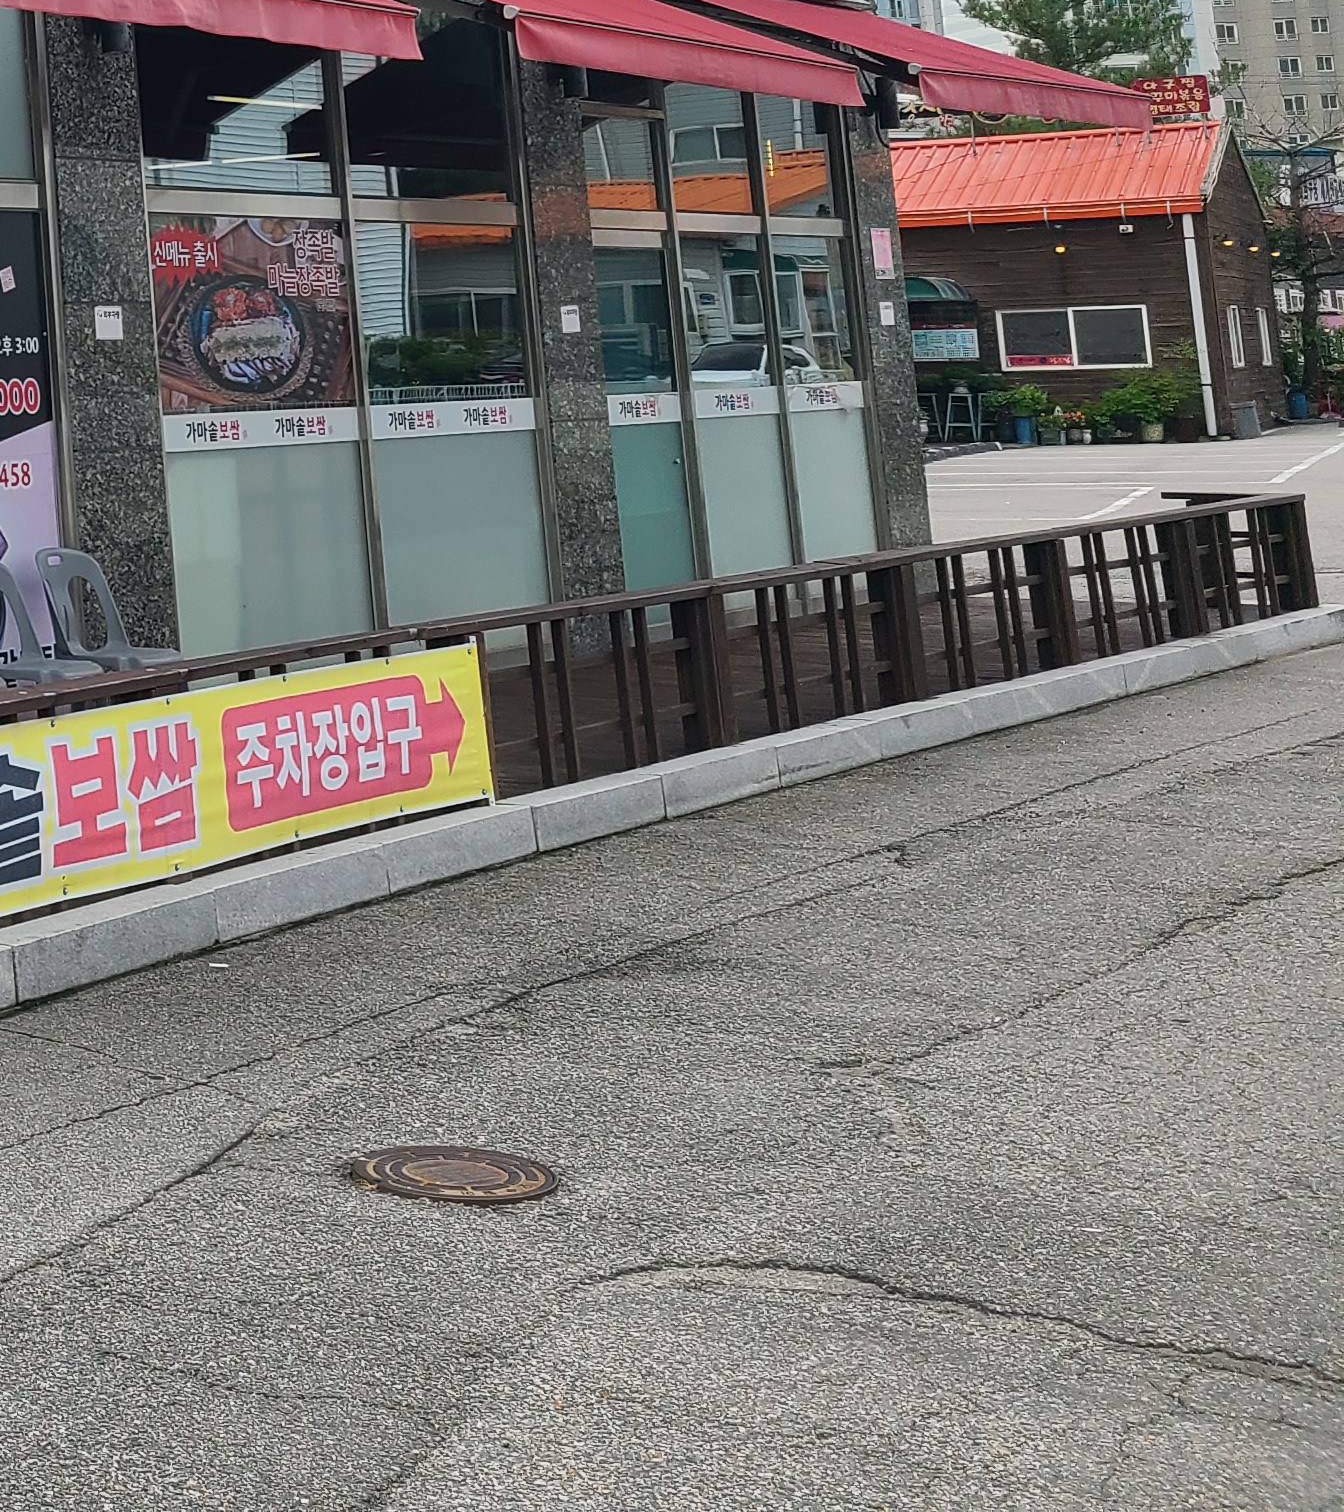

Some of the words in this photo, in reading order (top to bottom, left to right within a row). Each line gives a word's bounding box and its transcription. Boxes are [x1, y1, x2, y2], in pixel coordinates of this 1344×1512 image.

[1149, 88, 1206, 103] 꾸미볶음
[153, 240, 191, 268] 신메뉴
[193, 240, 218, 268] 출시
[292, 228, 335, 261] 장족발
[267, 262, 340, 297] 마늘장족발
[15, 336, 39, 354] 3:00
[619, 399, 657, 419] 가마솥보쌈
[714, 392, 751, 412] 가마솥보쌈
[274, 414, 327, 439] 가마솥보쌈
[388, 409, 435, 433] 가마솥보쌈
[462, 404, 507, 429] 가마솥보쌈
[185, 419, 240, 443] 가마솥보쌈
[233, 694, 424, 809] 주차장입구
